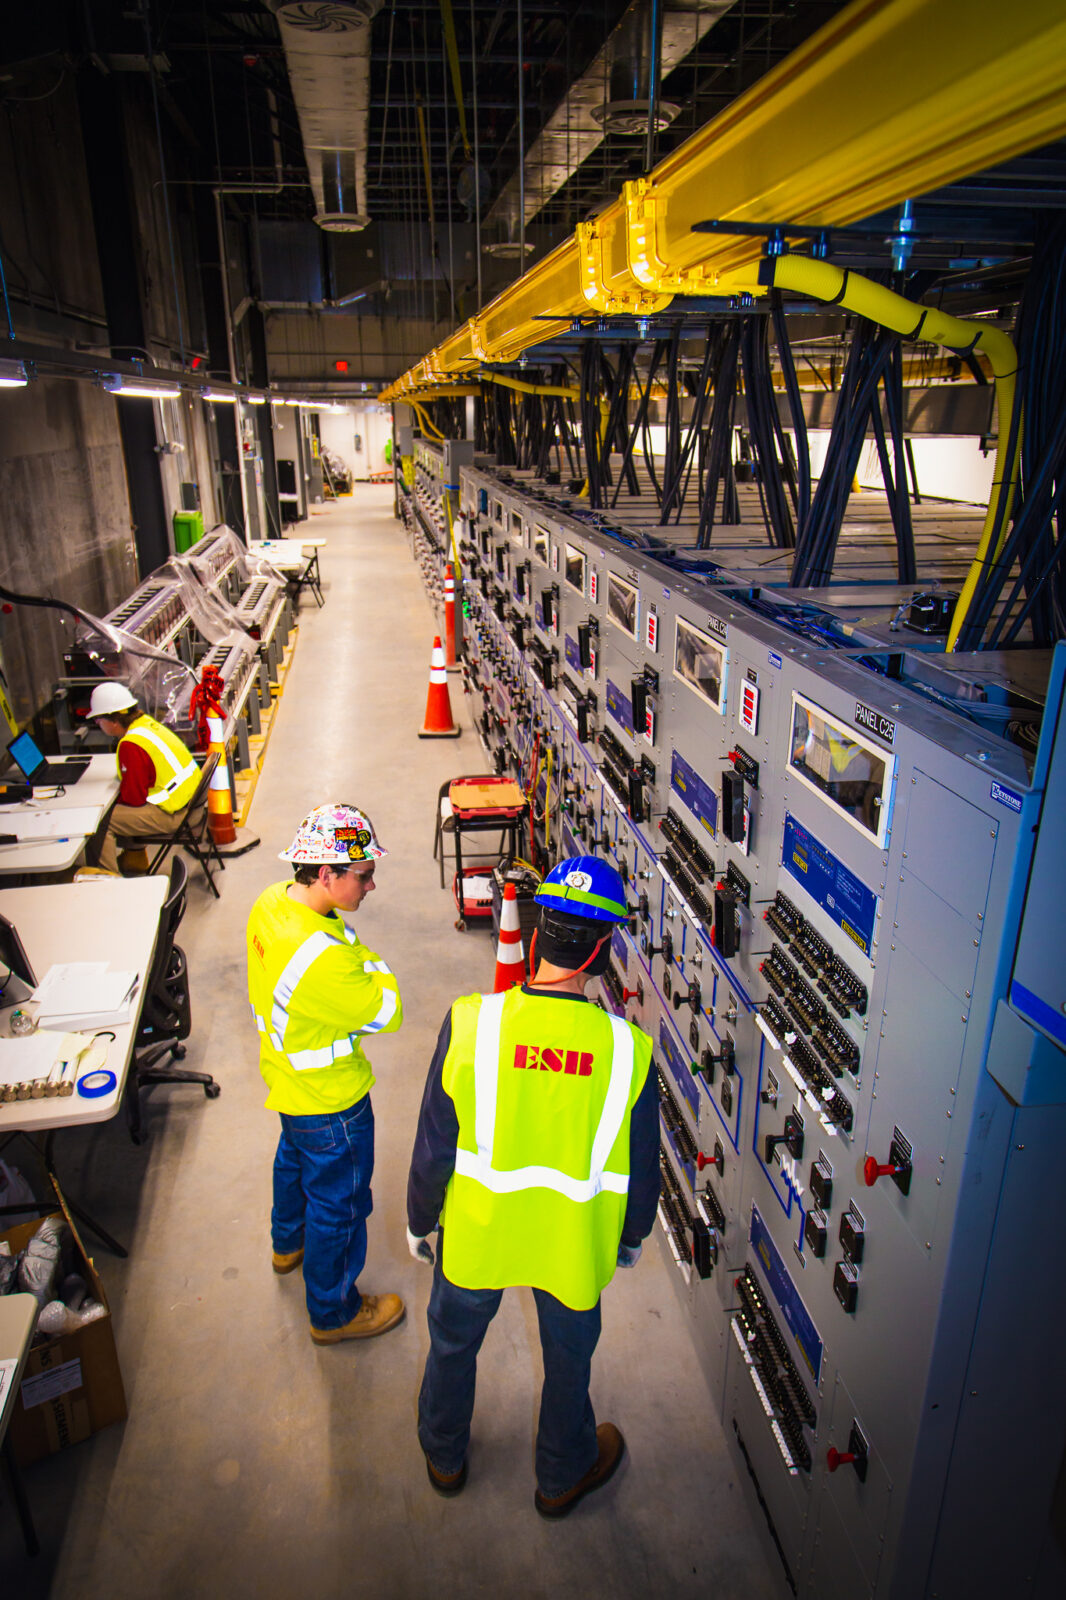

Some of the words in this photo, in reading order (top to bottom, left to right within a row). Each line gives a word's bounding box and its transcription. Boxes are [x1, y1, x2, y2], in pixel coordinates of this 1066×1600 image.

[707, 615, 720, 632] PANEL
[855, 703, 878, 731] PANEL
[879, 718, 894, 740] C25
[513, 1044, 594, 1077] ESB
